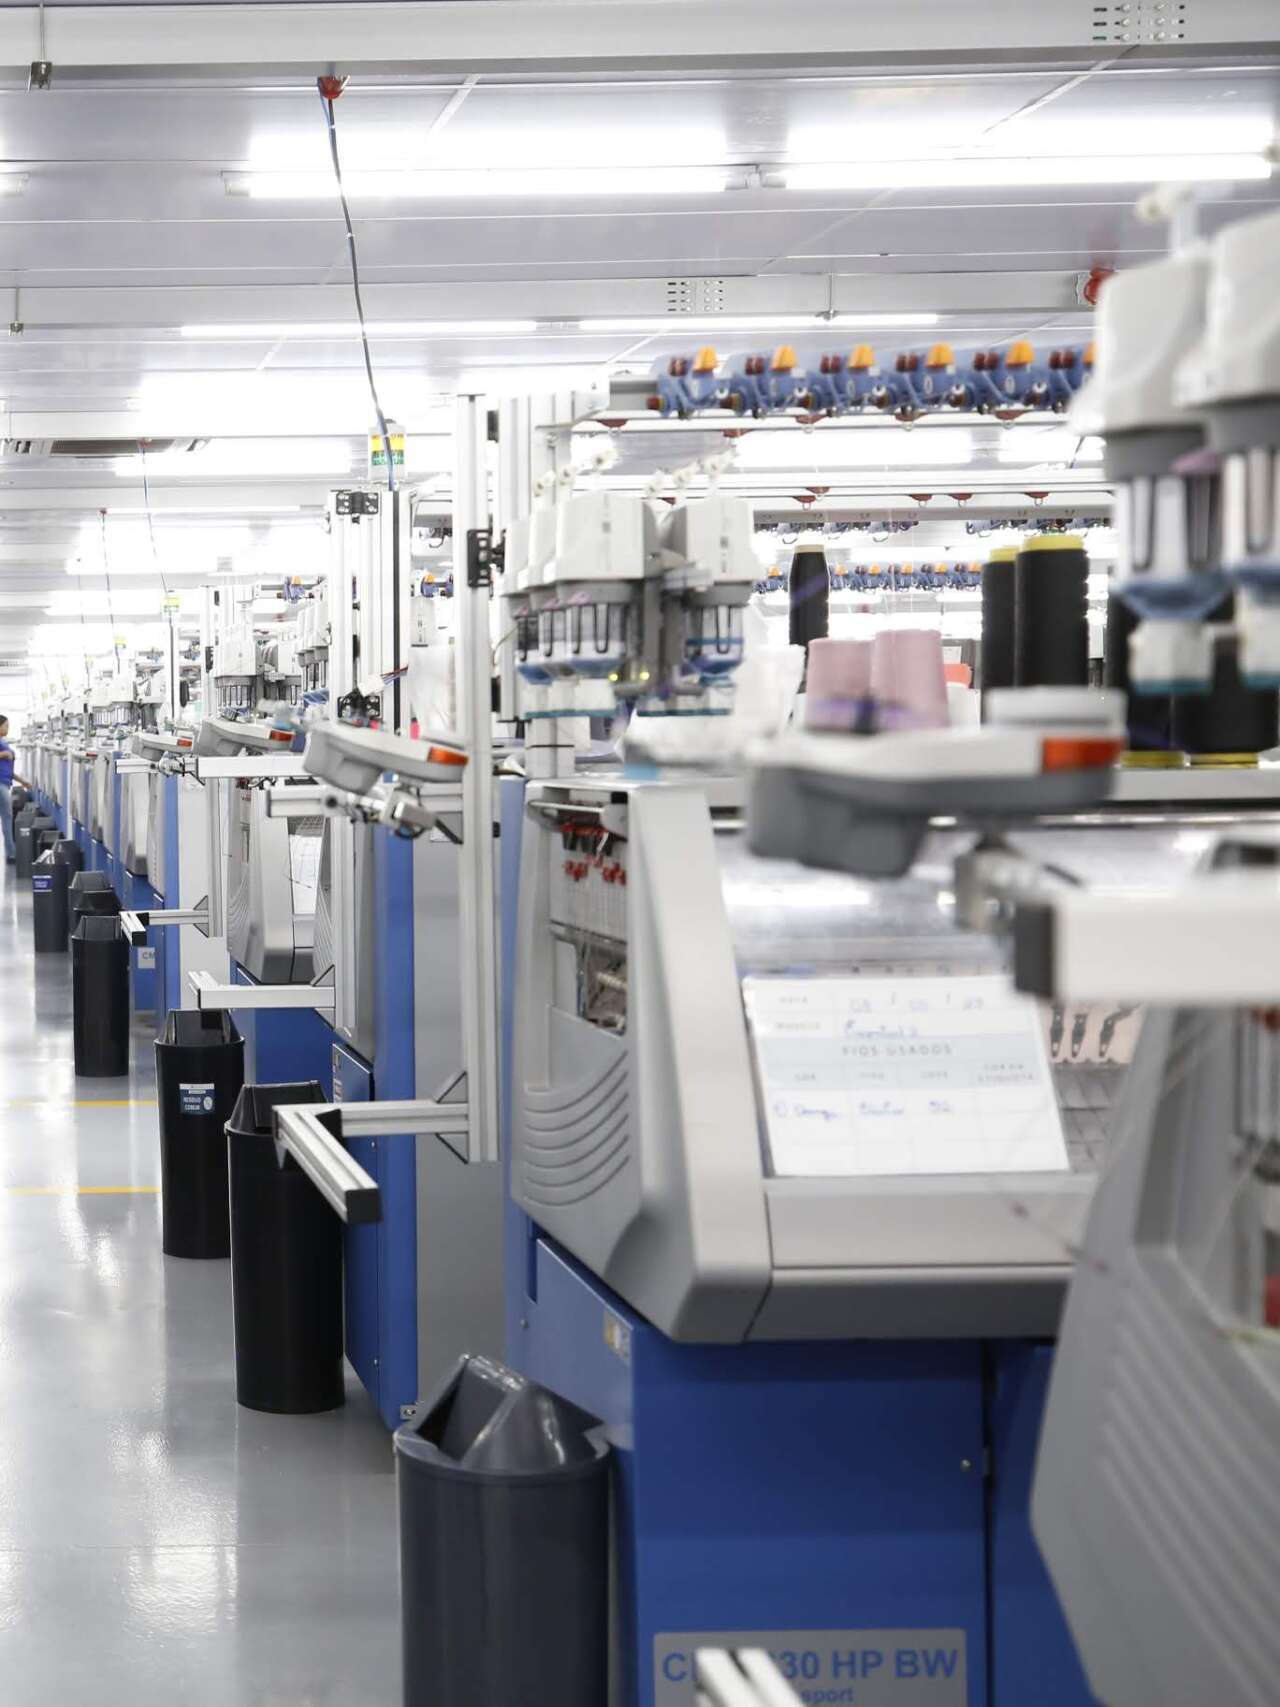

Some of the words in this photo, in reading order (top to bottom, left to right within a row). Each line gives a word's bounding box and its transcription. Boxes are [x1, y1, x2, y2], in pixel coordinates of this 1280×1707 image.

[770, 1651, 819, 1679] 30
[832, 1650, 882, 1679] HP
[894, 1649, 958, 1678] BW
[801, 1687, 854, 1704] sport
